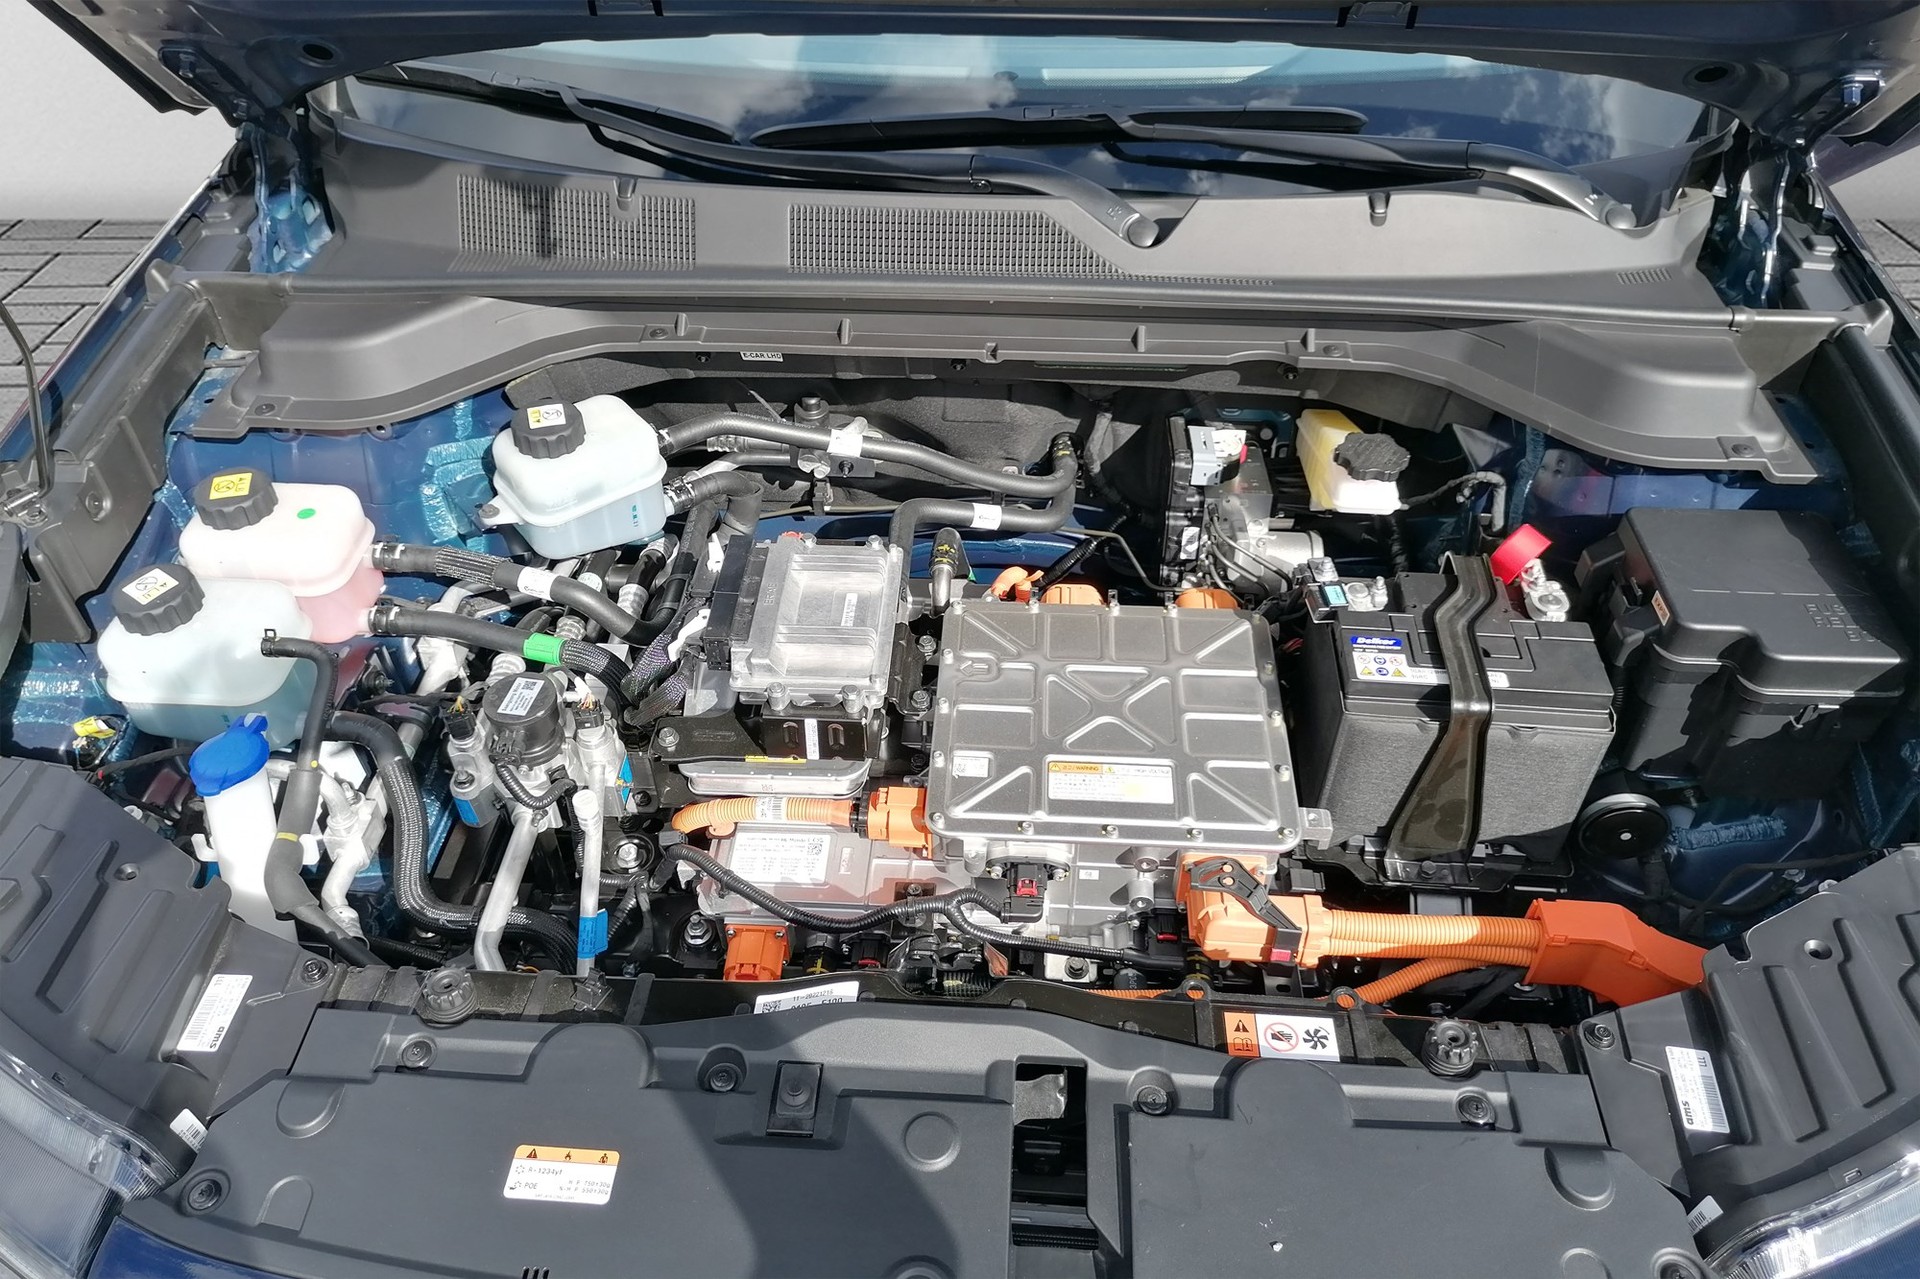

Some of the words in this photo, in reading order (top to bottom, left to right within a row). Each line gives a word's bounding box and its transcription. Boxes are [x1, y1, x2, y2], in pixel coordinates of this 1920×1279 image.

[209, 1026, 225, 1049] ams
[1681, 1100, 1694, 1126] ams
[523, 1182, 538, 1190] POE
